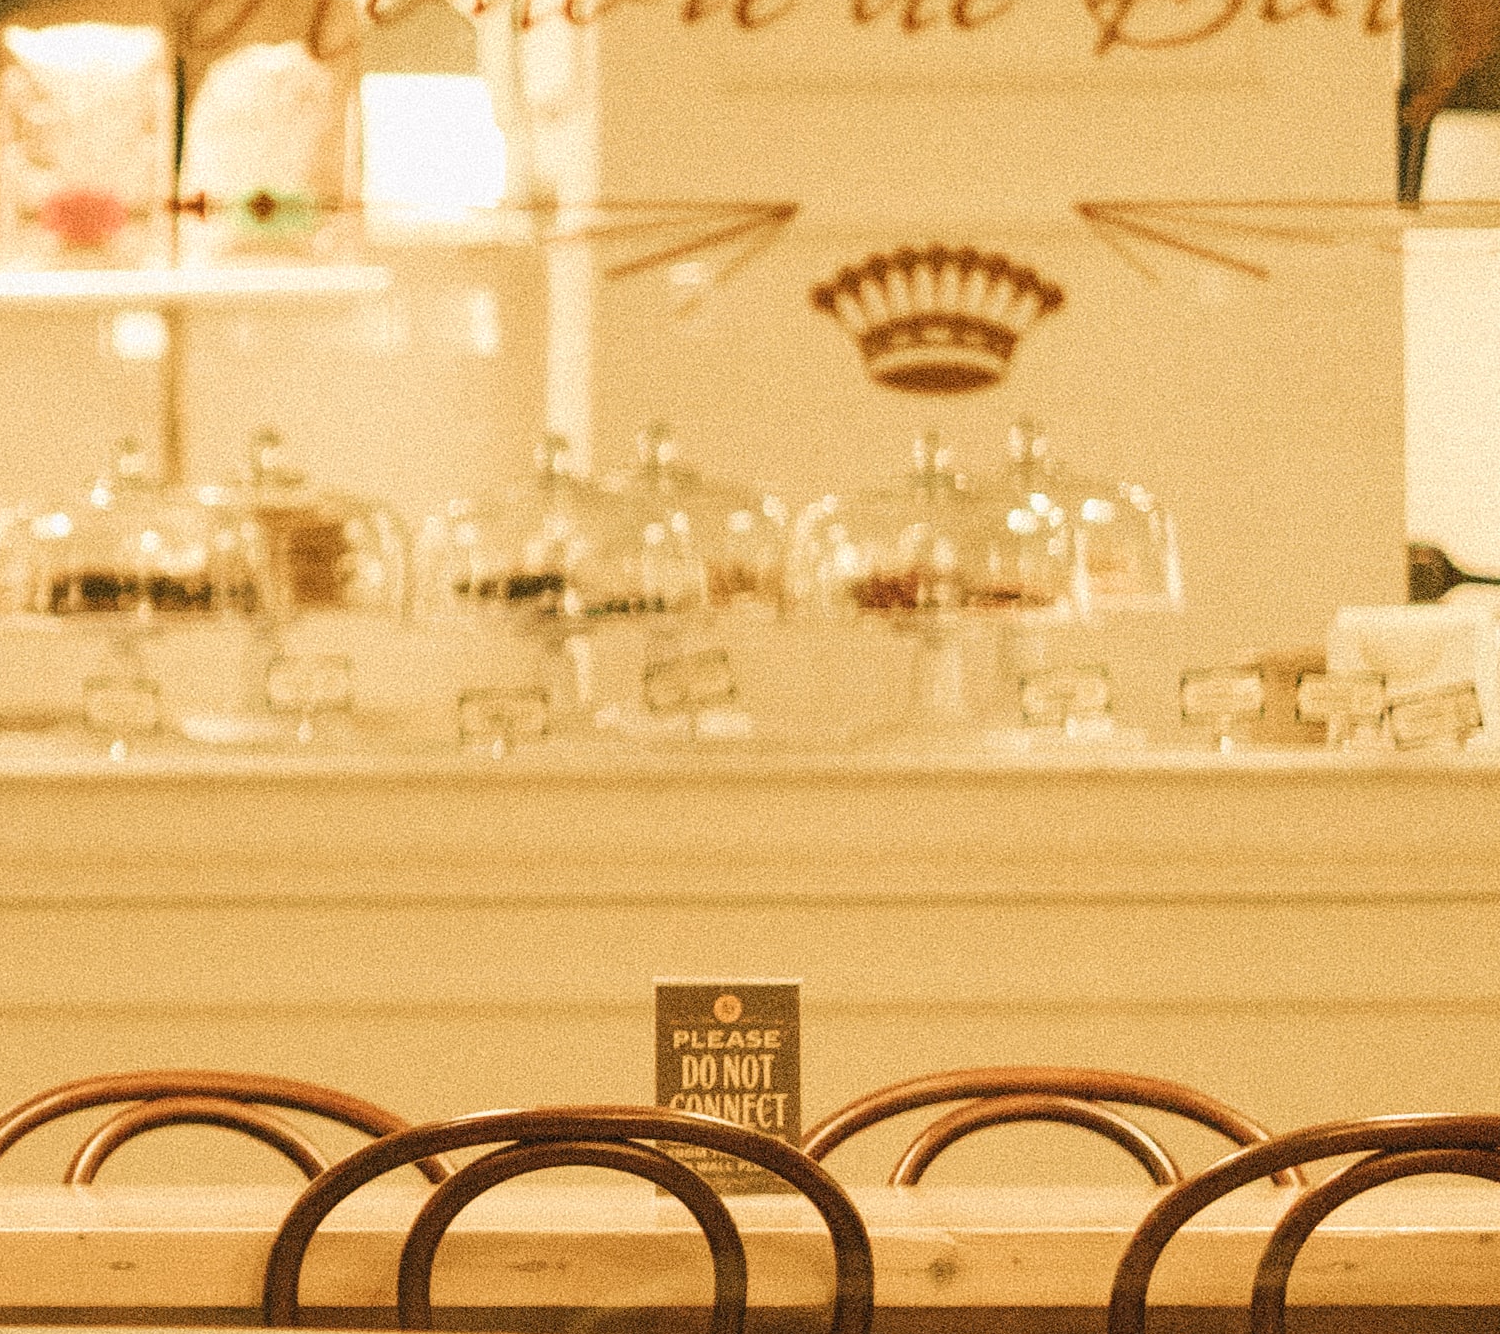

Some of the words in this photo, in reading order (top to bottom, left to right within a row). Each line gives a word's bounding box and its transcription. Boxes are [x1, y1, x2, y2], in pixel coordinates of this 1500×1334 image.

[672, 1029, 782, 1049] PLEASE
[681, 1053, 718, 1090] DO
[723, 1053, 775, 1090] NOT
